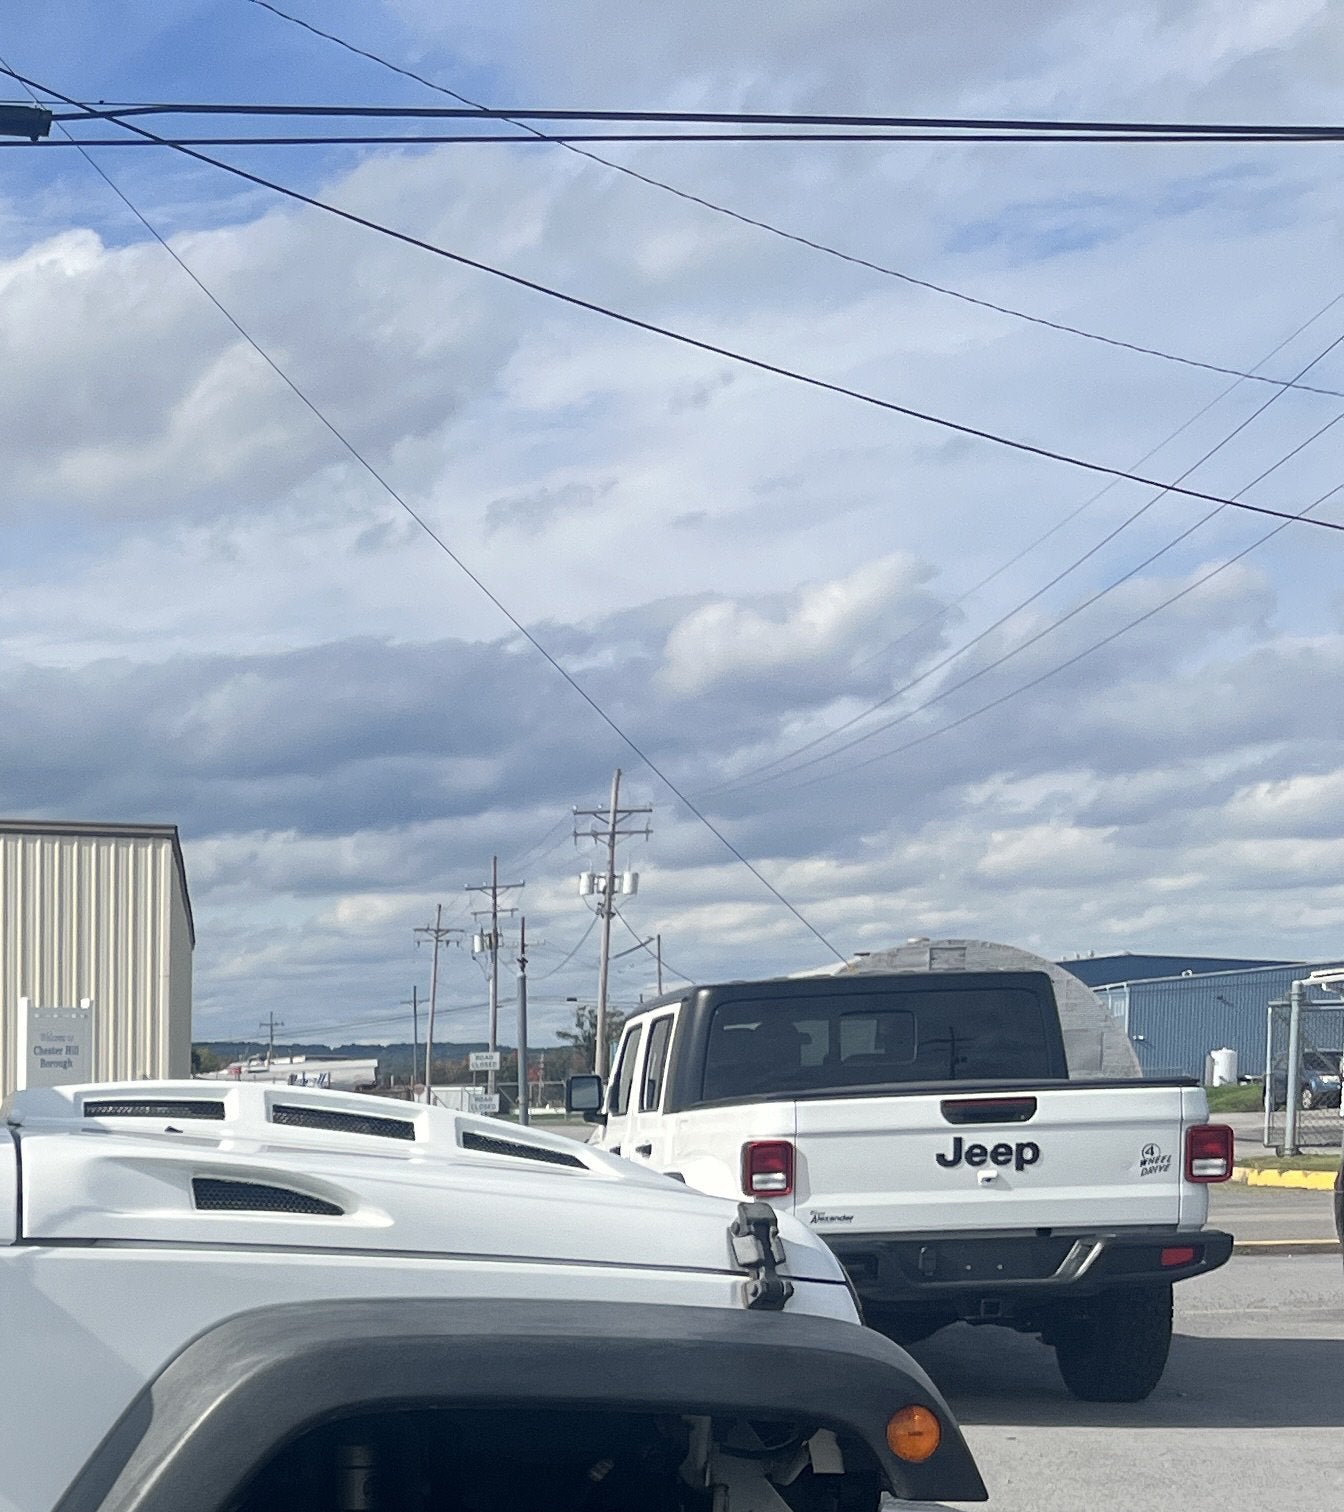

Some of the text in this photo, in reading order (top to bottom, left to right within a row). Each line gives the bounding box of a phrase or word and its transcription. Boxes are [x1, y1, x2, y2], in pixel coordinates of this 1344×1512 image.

[33, 1045, 80, 1056] Chester Hill
[40, 1058, 73, 1070] Borough
[936, 1136, 1040, 1171] Jeep
[1140, 1154, 1172, 1168] WHEEL
[1141, 1163, 1172, 1177] DRIVE
